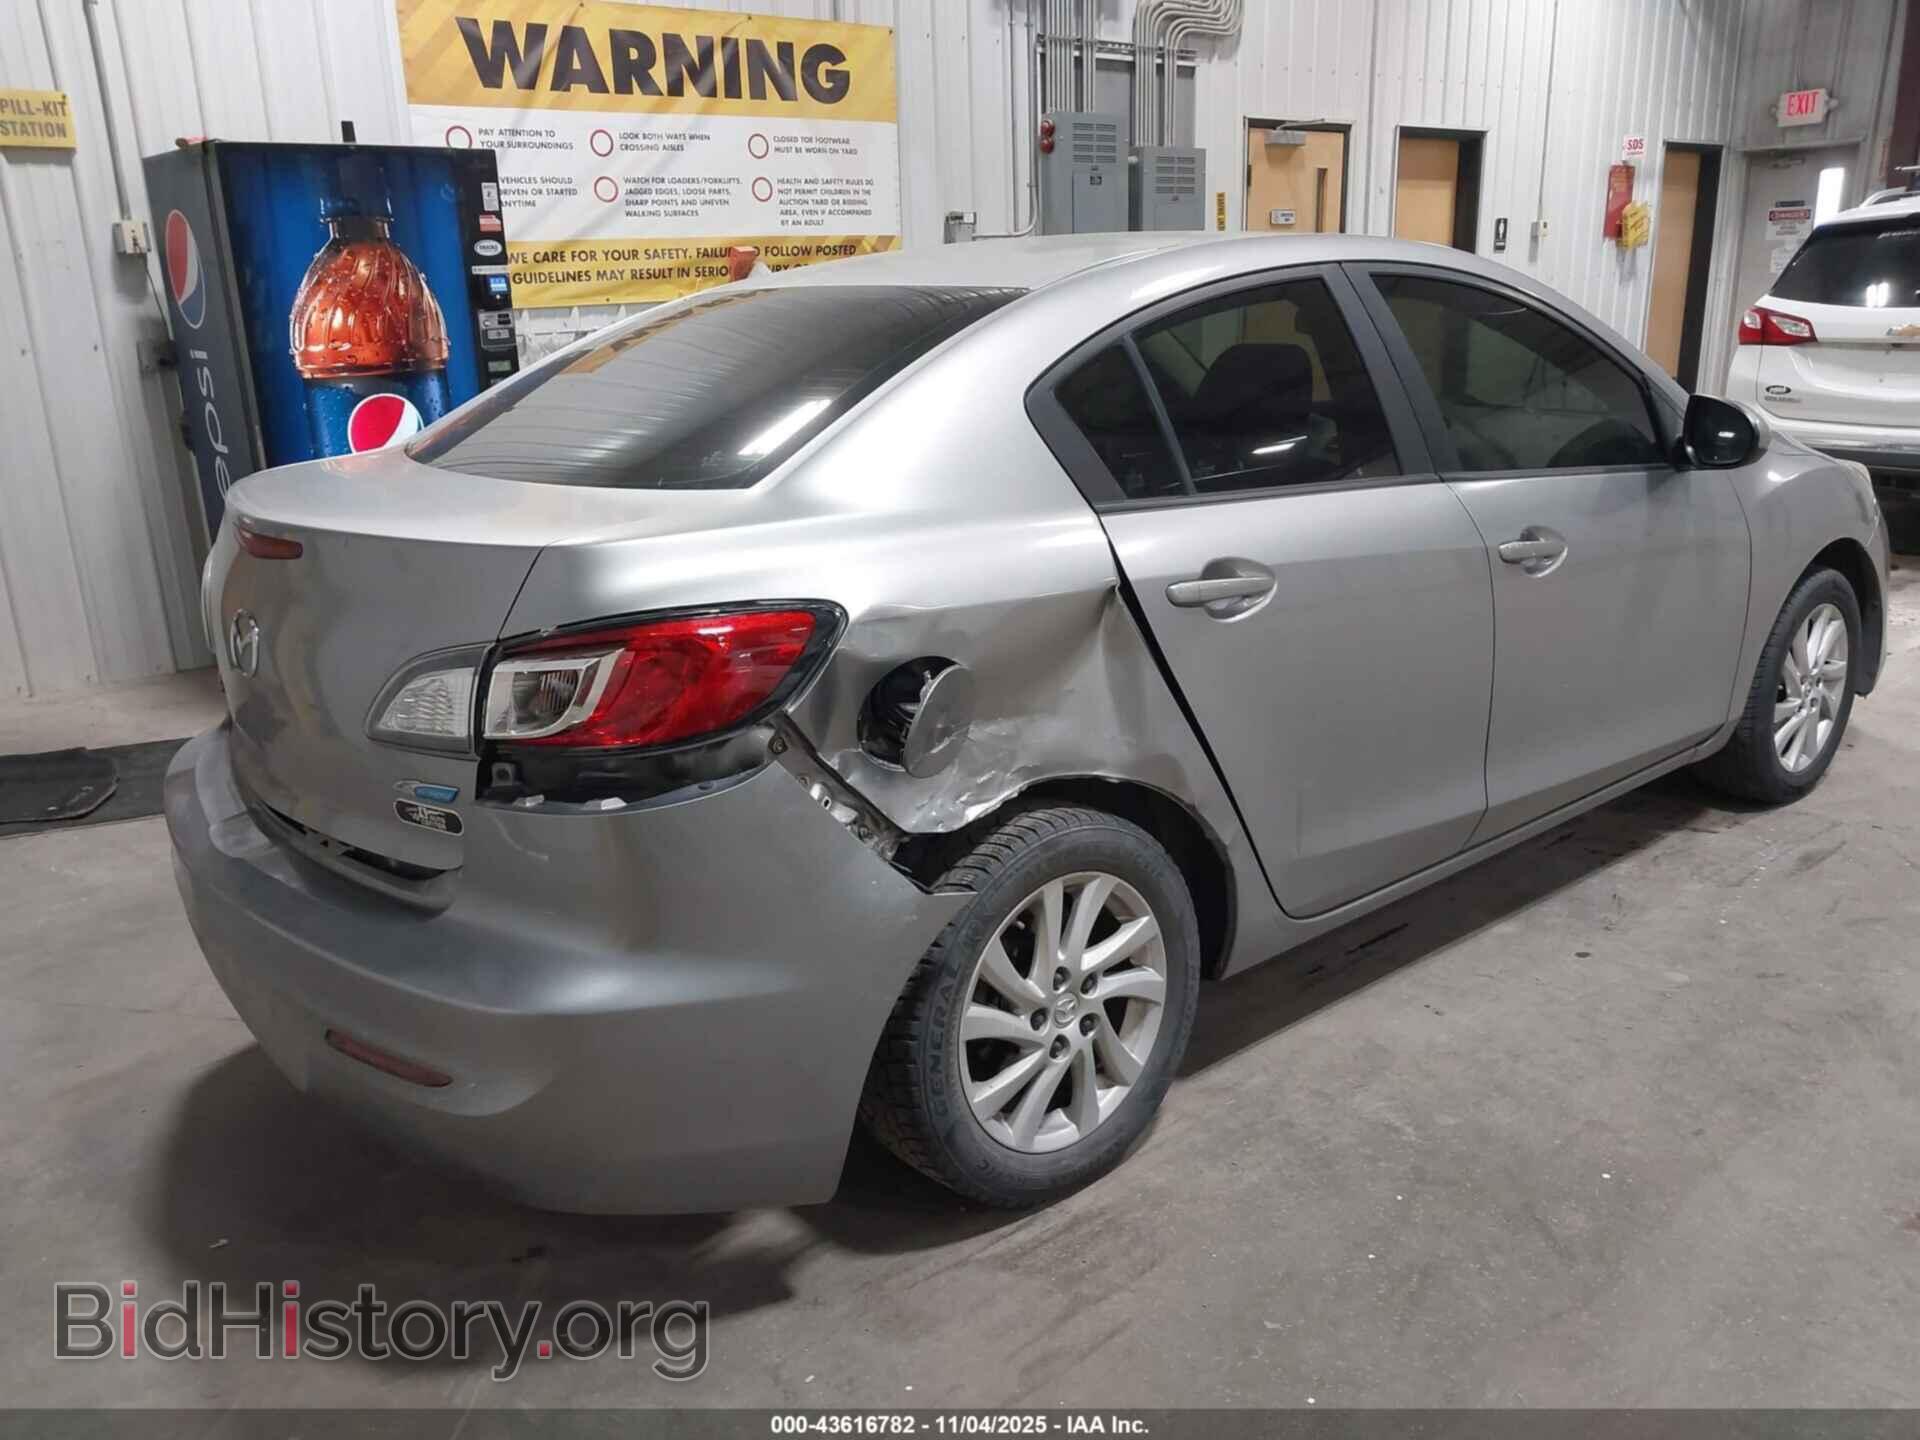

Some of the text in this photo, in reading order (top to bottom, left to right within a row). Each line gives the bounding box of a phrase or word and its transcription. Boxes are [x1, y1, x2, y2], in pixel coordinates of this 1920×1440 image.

[456, 16, 850, 104] WARNING
[0, 98, 66, 117] PILL-KIT
[1786, 91, 1819, 116] EXIT
[0, 120, 67, 138] STATION
[478, 128, 494, 136] PAY
[498, 128, 542, 137] ATTENTION
[619, 132, 639, 140] LOOK
[642, 132, 663, 140] BOTH
[666, 133, 687, 141] WAYS
[815, 137, 850, 145] FOOTWEAR
[480, 140, 574, 149] YOUR SURROUNDINGS
[620, 143, 684, 151] CROSSING AISLES
[500, 176, 574, 184] VEHICLES SHOULD
[499, 188, 578, 196] DRIVEN OR STARTED
[625, 188, 653, 196] JAGGED
[682, 188, 706, 196] LOOSE
[625, 199, 649, 207] SHARP
[651, 199, 679, 207] POINTS
[699, 198, 730, 206] UNEVEN
[625, 210, 700, 218] WALKING SURFACES
[533, 250, 567, 263] CARE
[571, 250, 598, 262] FOR
[602, 249, 639, 262] YOUR
[697, 247, 731, 259] FAILU
[765, 245, 813, 257] FOLLOW
[816, 244, 857, 256] POSTED
[512, 270, 592, 285] GUIDELINES
[597, 268, 625, 281] MAY
[630, 267, 673, 280] RESULT
[677, 267, 690, 279] IN
[695, 265, 729, 278] SERIO
[190, 348, 231, 500] epsi
[927, 964, 959, 1117] GENERAL
